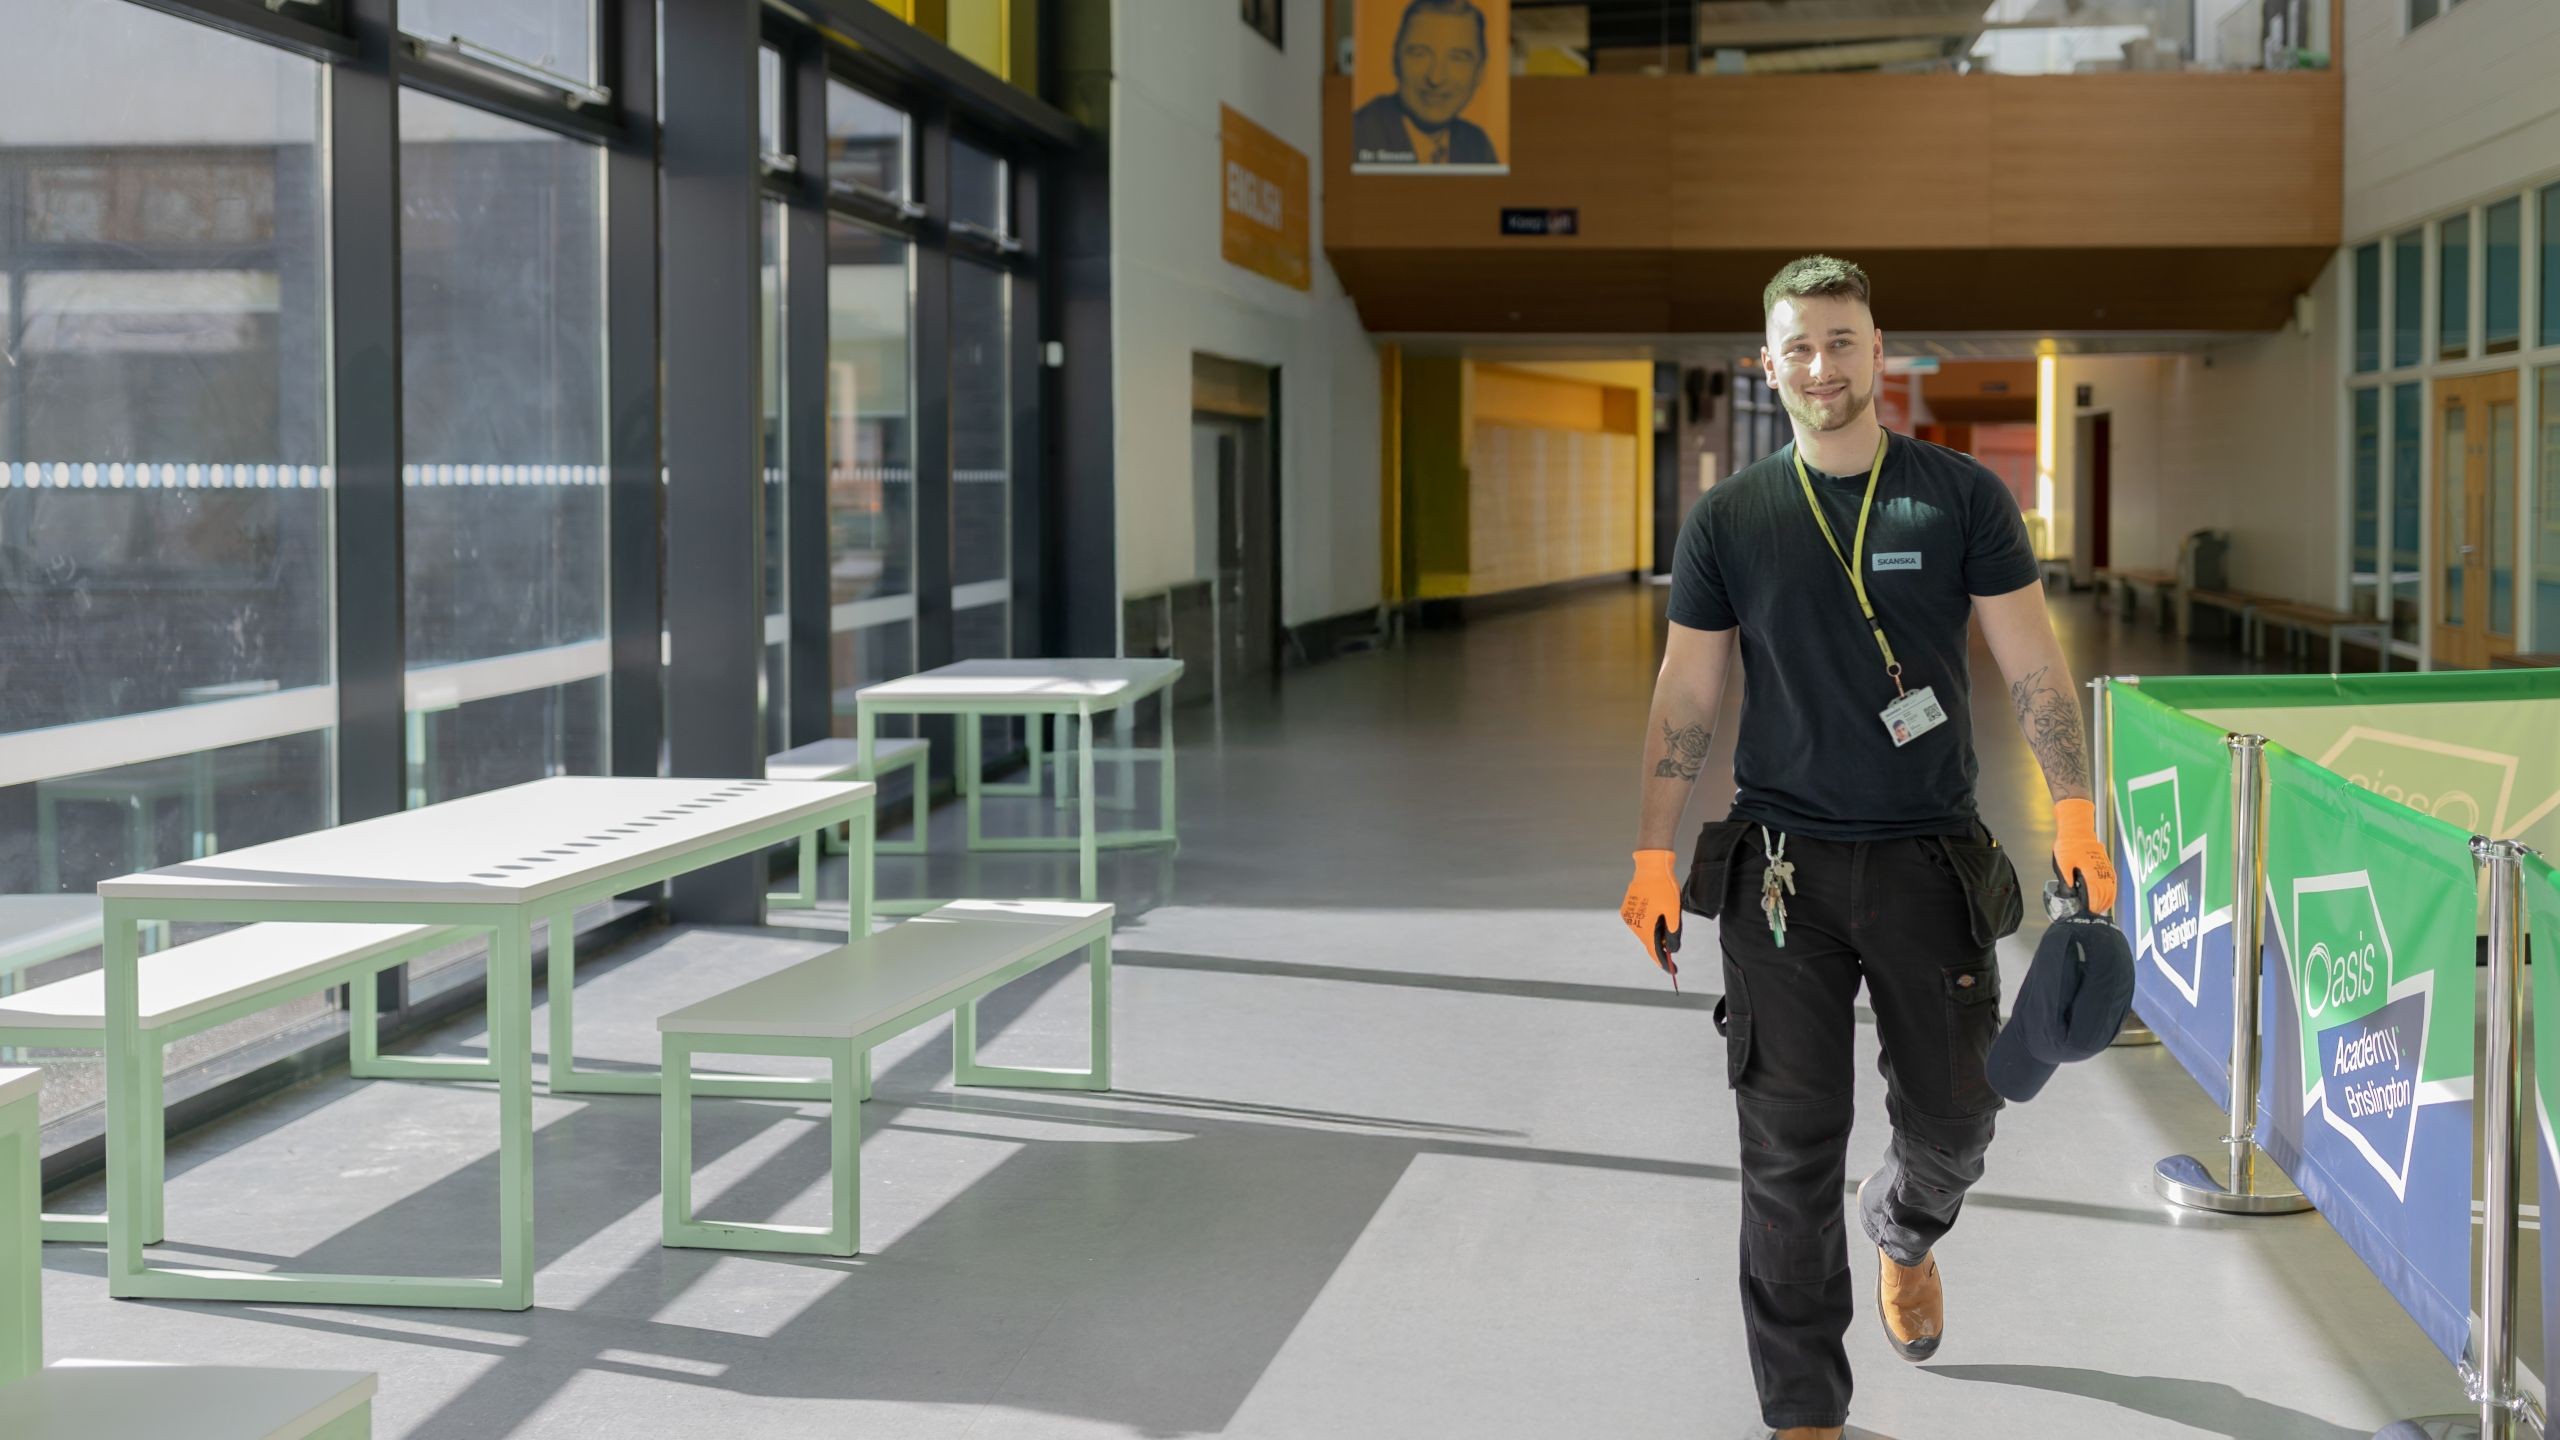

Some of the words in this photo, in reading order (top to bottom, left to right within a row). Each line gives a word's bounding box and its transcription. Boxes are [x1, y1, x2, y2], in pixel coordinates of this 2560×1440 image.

[1227, 160, 1282, 231] ENGLISH
[1877, 557, 1917, 566] SKANSKA
[2136, 812, 2171, 884] Oasis
[2161, 916, 2198, 954] Brislington
[2305, 930, 2375, 1018] Oasis
[2345, 1077, 2411, 1119] Brislington
